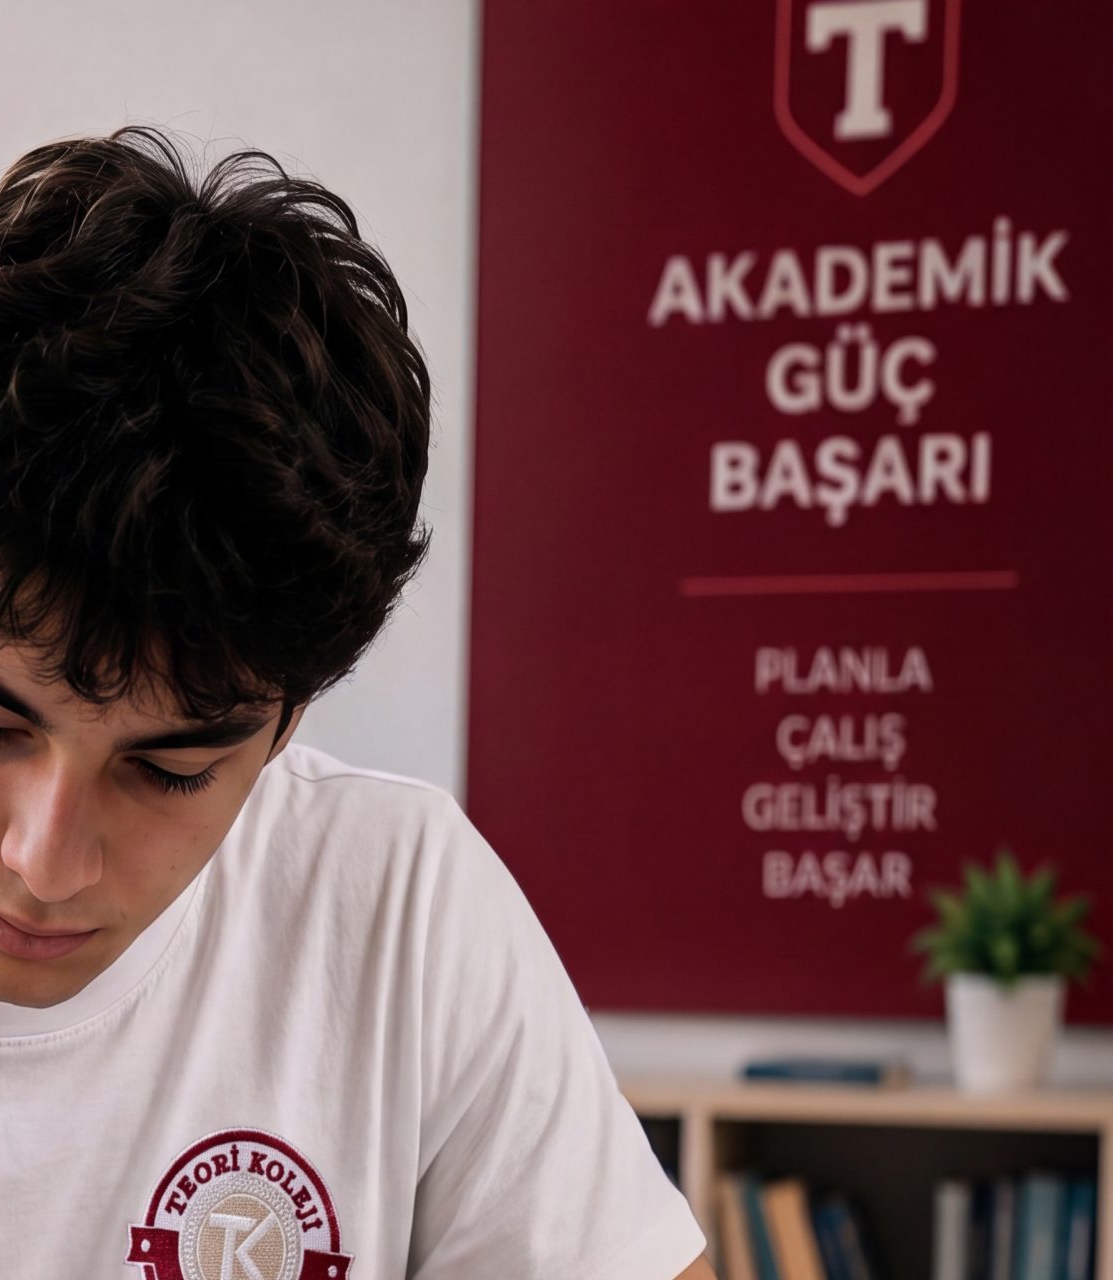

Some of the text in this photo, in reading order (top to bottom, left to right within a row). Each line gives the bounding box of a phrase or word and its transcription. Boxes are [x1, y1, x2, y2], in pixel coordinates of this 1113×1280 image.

[807, 0, 928, 140] T
[648, 216, 1070, 328] AKADEMİK
[765, 323, 936, 426] GÜÇ
[709, 432, 992, 527] BAŞARI
[753, 646, 934, 695] PLANLA
[775, 712, 907, 771] ÇALIŞ
[740, 773, 938, 842] GELİŞTİR
[761, 850, 914, 909] BAŞAR
[164, 1144, 240, 1216] TEORİ
